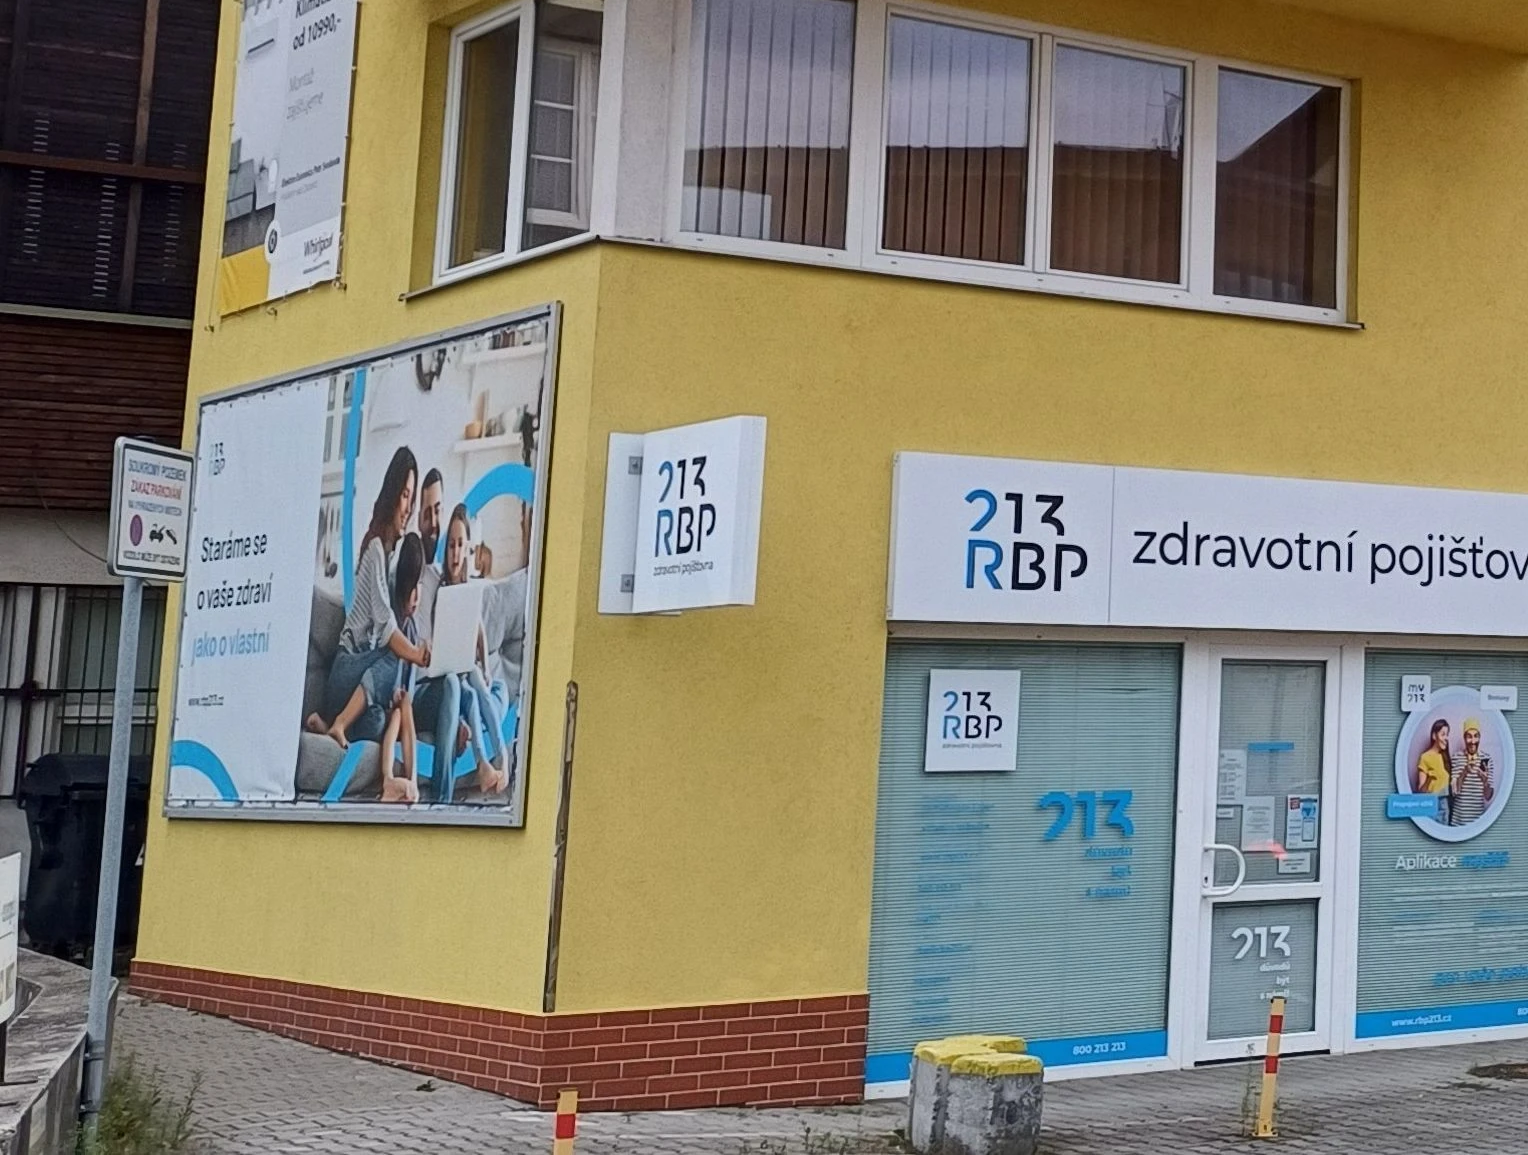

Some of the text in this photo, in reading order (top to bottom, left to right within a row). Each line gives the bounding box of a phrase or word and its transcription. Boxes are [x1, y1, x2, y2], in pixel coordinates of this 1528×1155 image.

[293, 12, 342, 50] od 10990,-
[658, 456, 707, 503] 213
[654, 503, 717, 557] RBP
[964, 489, 1065, 537] 213
[202, 530, 268, 562] Staráme se
[965, 539, 1088, 592] RBP
[1132, 521, 1357, 573] zdravotní
[197, 572, 273, 610] o vaše zdraví
[192, 622, 270, 665] jako o vlastní
[944, 691, 992, 711] 213
[942, 715, 1003, 739] RBP
[1037, 790, 1134, 841] 213
[1395, 852, 1457, 870] Aplikace
[1231, 926, 1291, 959] 213
[1073, 1042, 1126, 1055] 800 213 213
